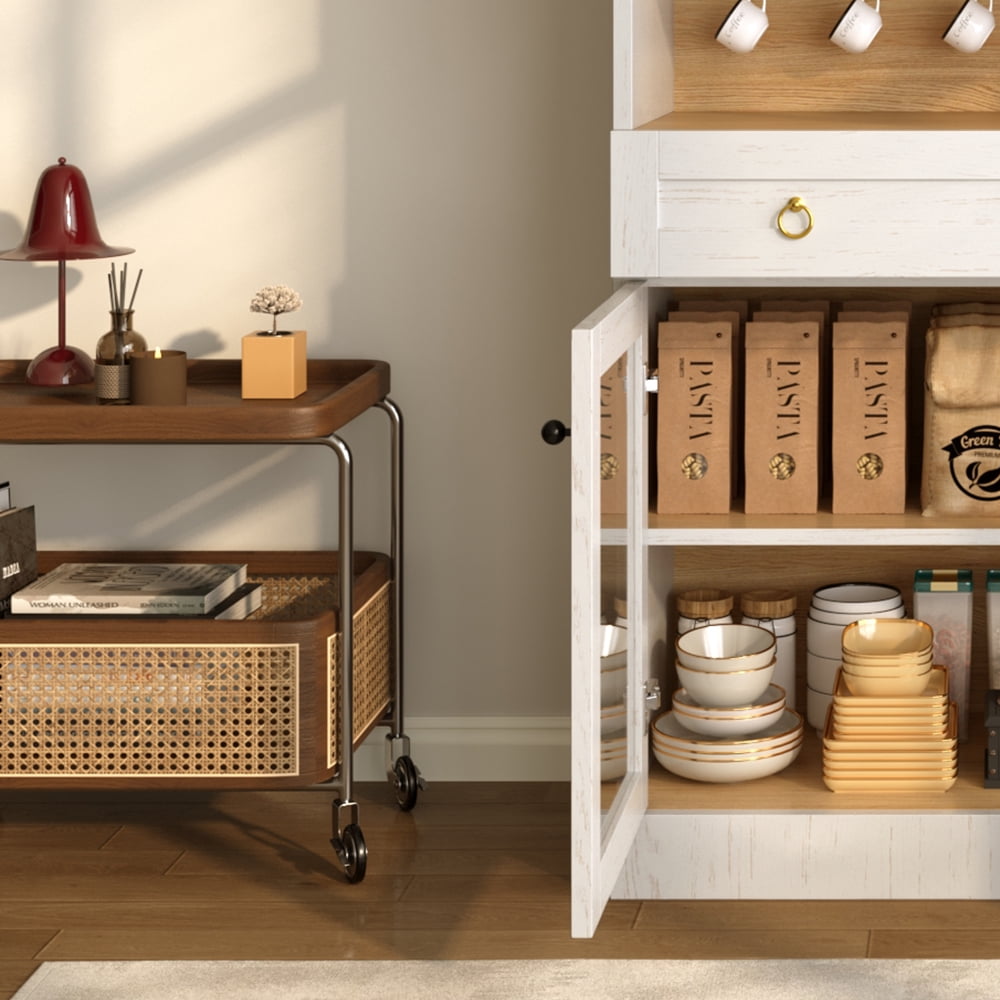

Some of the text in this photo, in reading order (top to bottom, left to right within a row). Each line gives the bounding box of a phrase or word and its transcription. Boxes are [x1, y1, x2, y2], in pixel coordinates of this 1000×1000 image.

[688, 361, 713, 440] PASTA
[776, 361, 801, 440] PASTA
[864, 361, 888, 440] PASTA
[960, 435, 994, 449] Green
